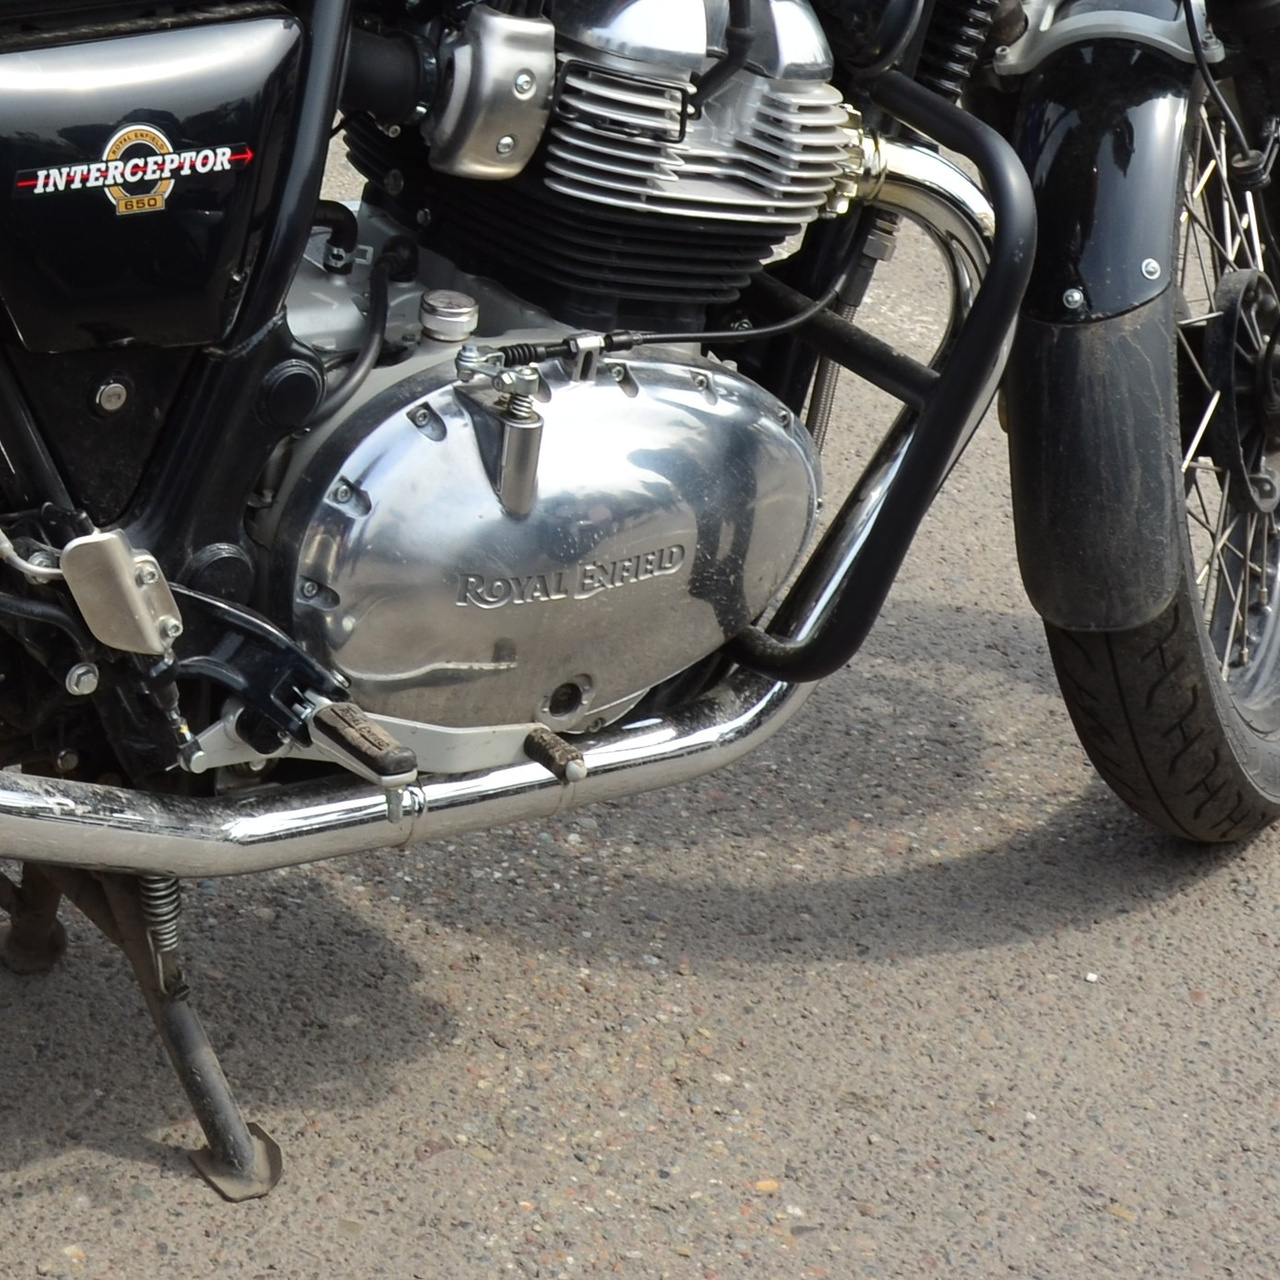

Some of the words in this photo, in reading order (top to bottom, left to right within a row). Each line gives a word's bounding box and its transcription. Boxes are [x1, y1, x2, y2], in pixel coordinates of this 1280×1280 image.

[111, 135, 131, 156] ROYAL
[134, 132, 165, 150] ENFIELD
[33, 147, 232, 194] INTERCEPTOR
[124, 197, 158, 210] 650
[455, 571, 568, 609] ROYAL
[573, 543, 686, 599] ENFIELD
